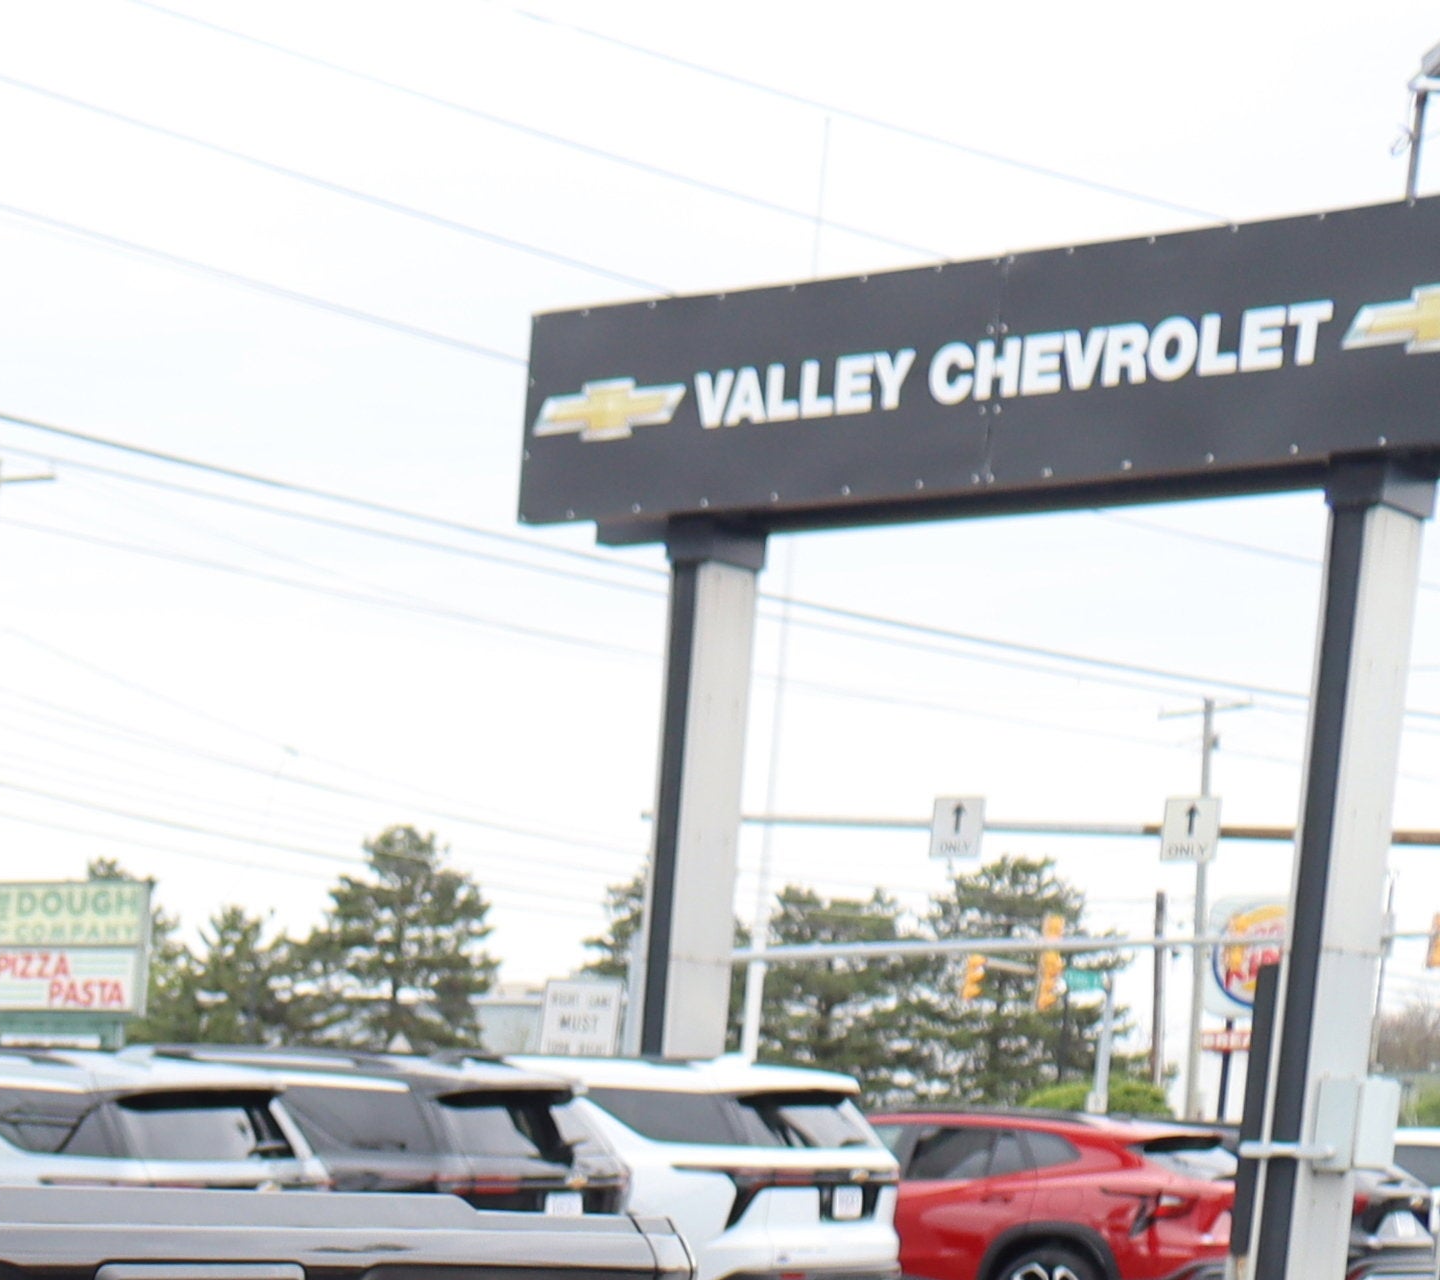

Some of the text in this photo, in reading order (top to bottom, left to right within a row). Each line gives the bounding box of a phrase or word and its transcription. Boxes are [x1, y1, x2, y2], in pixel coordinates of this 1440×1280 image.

[695, 300, 1333, 429] VALLEY CHEVROLET
[1168, 845, 1208, 857] ONLY
[15, 889, 139, 918] DOUGH
[48, 978, 126, 1007] PASTA
